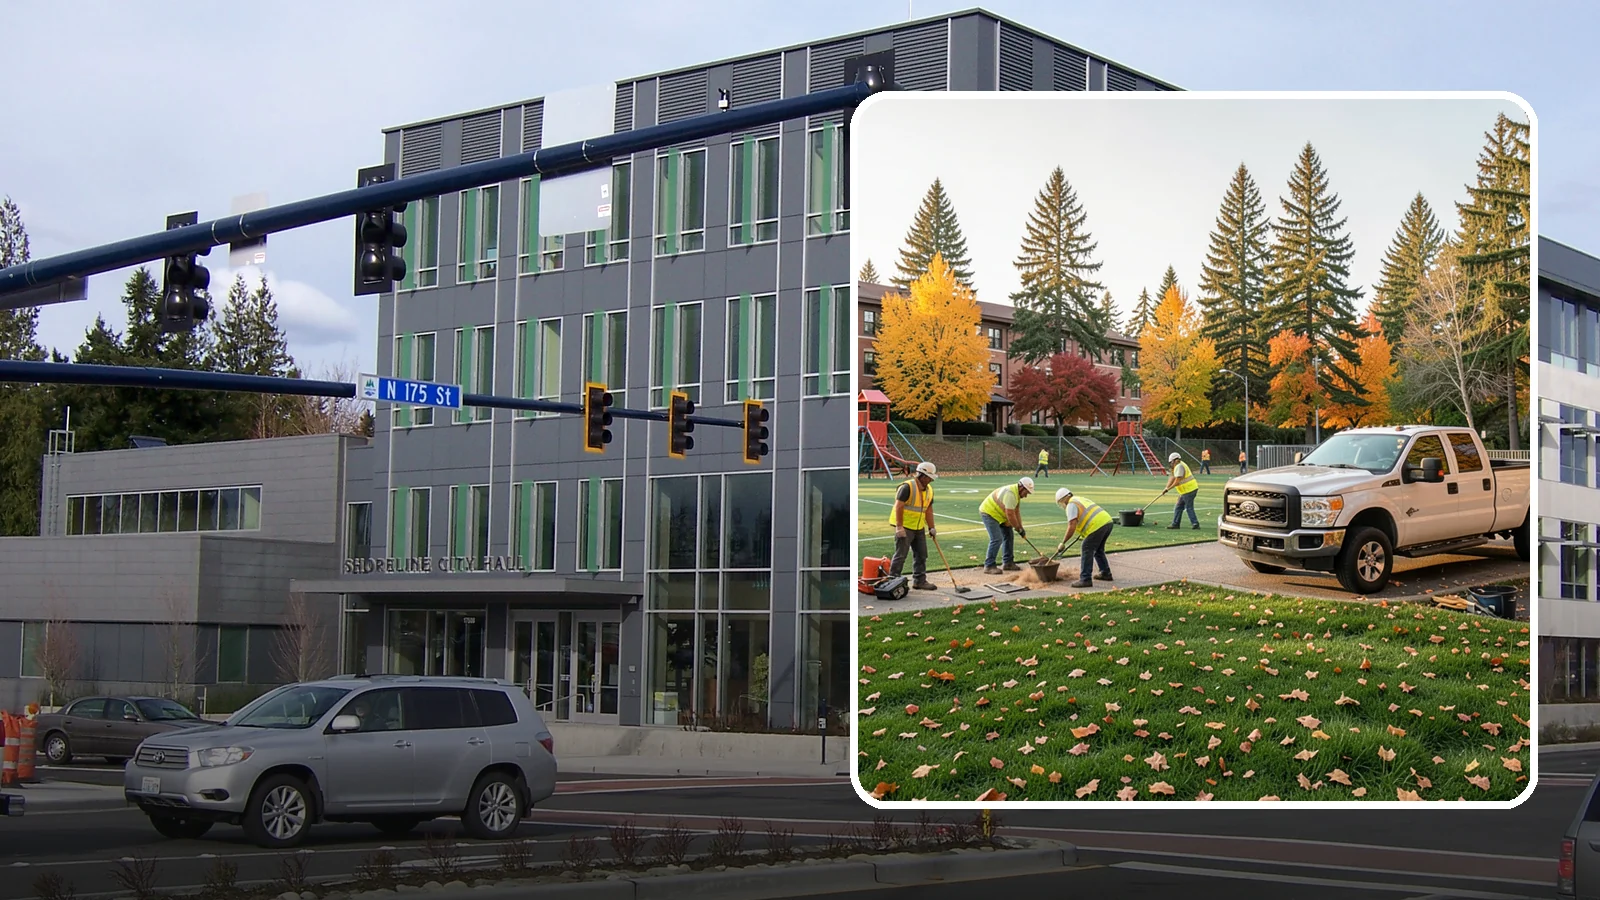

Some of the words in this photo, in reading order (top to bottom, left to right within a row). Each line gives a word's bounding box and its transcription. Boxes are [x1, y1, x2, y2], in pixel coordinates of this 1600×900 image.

[387, 380, 396, 400] N
[405, 382, 428, 403] 175
[436, 386, 451, 406] St
[345, 556, 432, 574] SHORELINE
[438, 556, 475, 572] CITY
[484, 555, 525, 572] HALL
